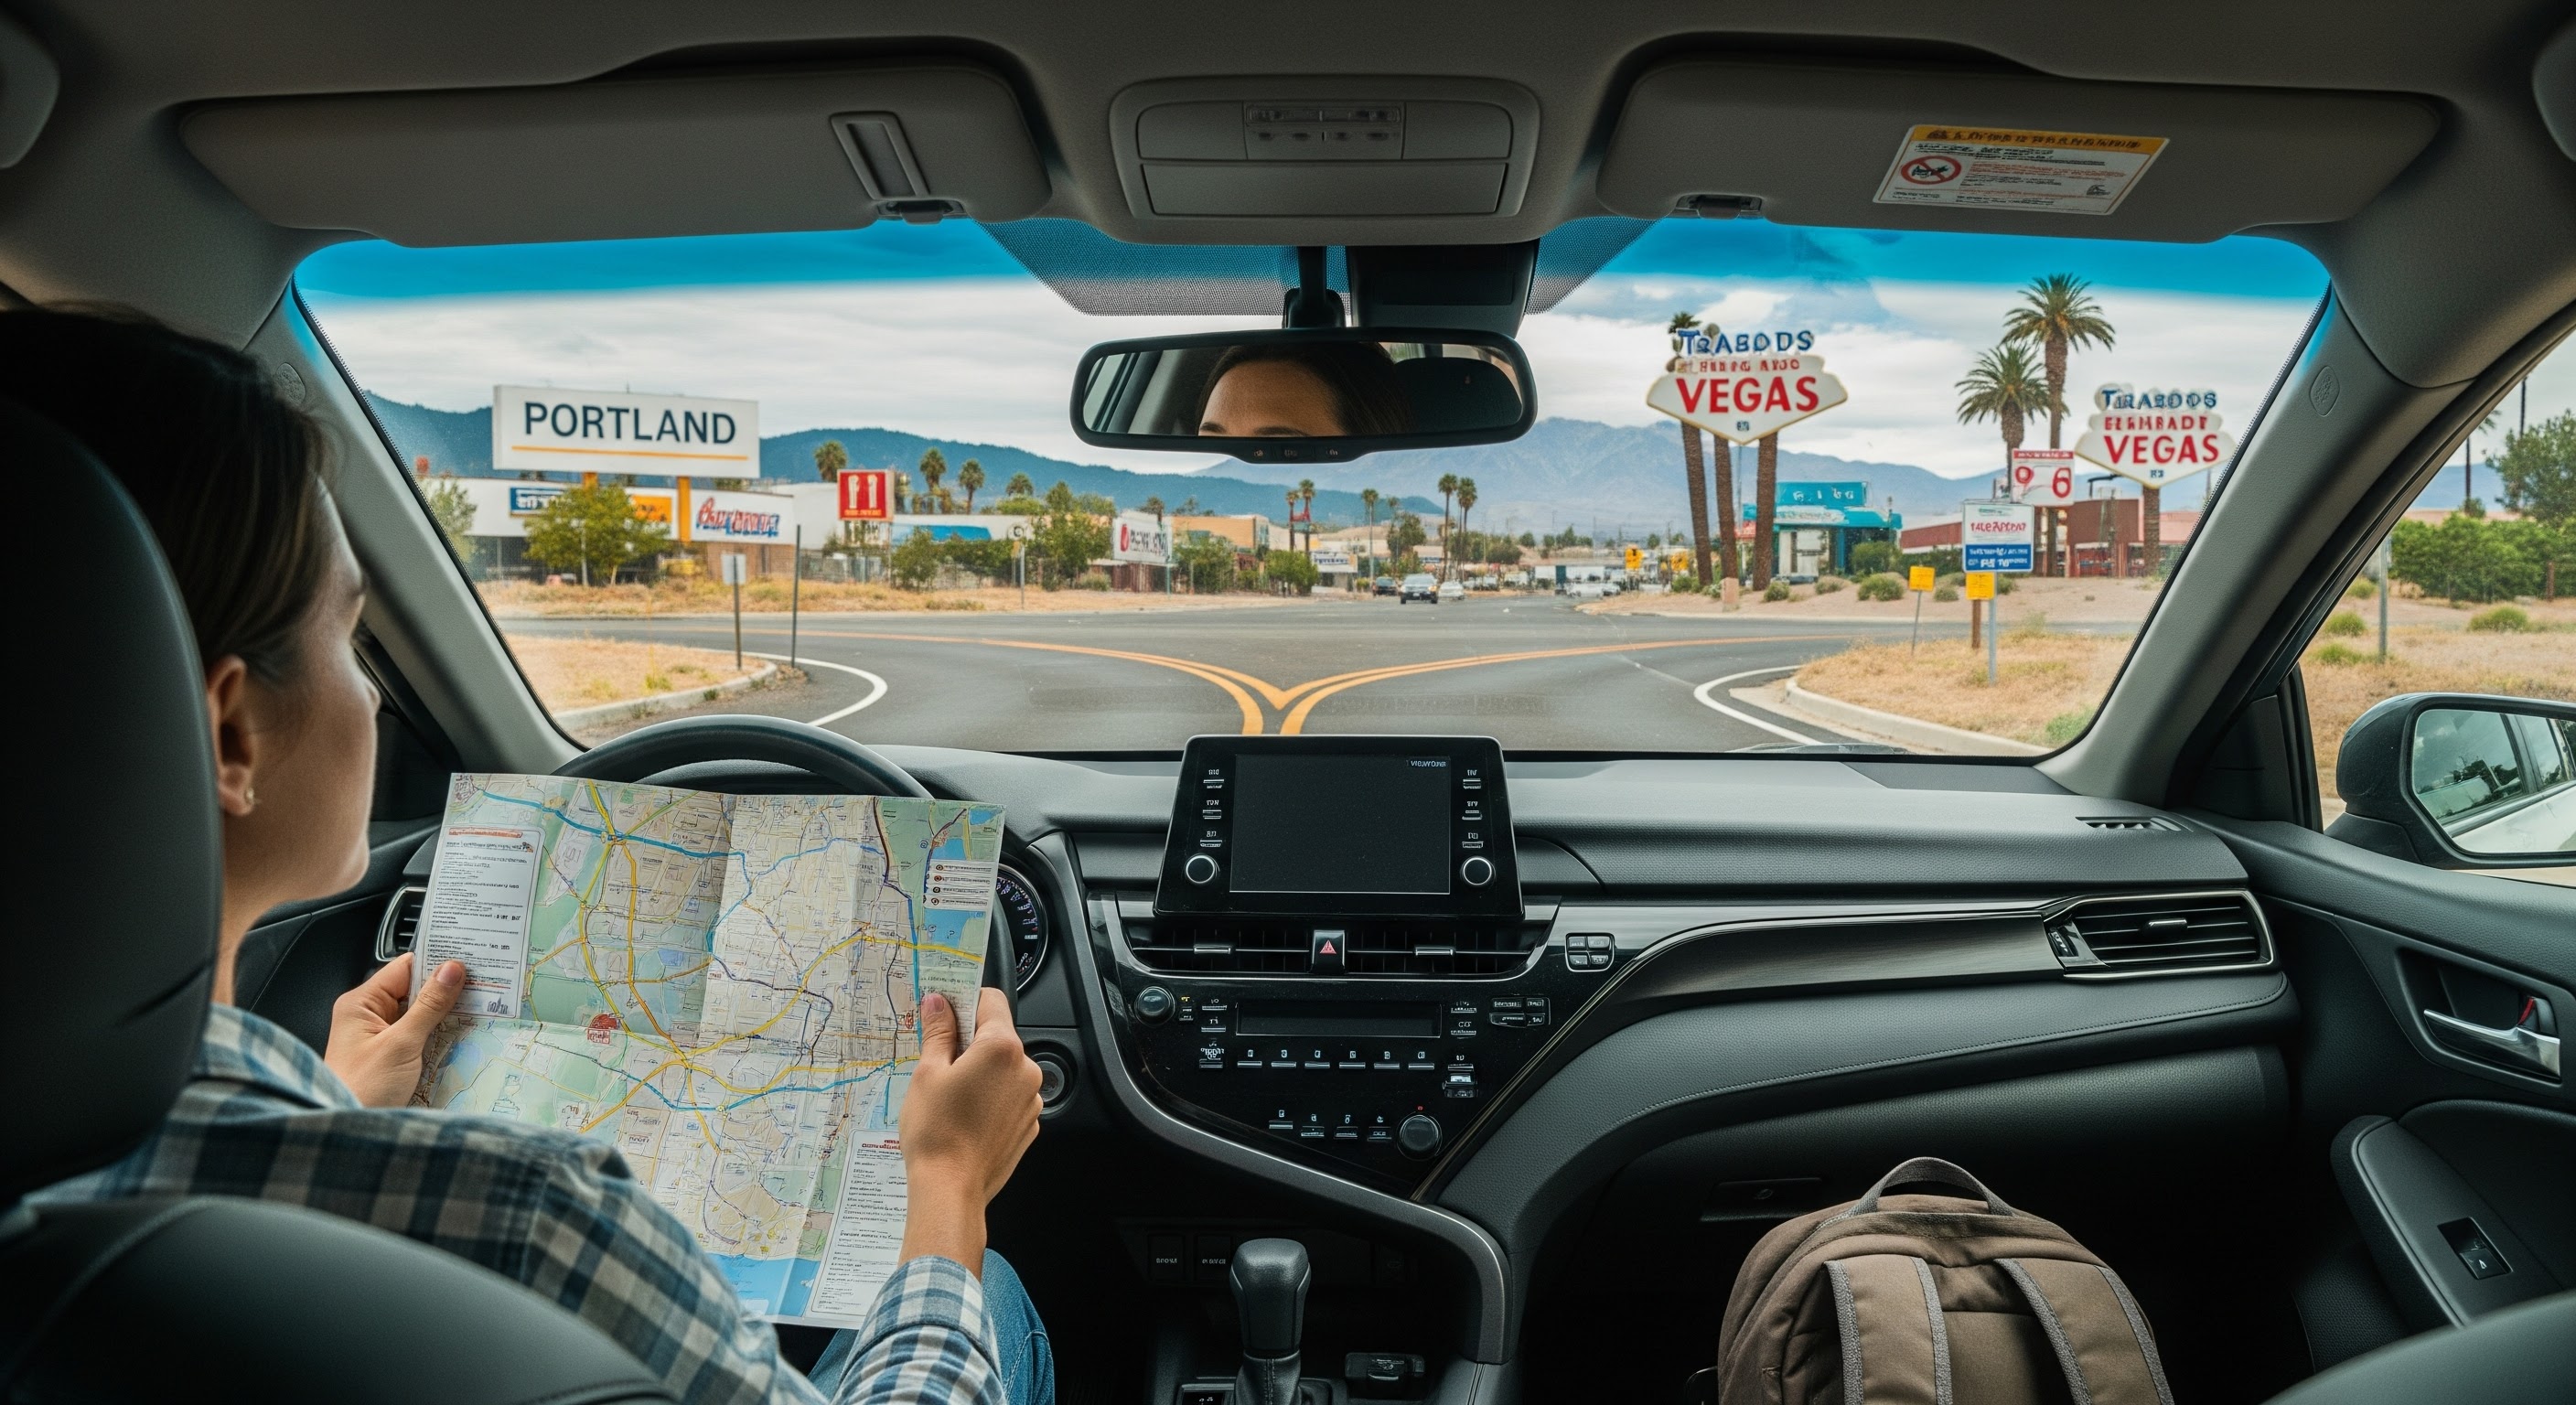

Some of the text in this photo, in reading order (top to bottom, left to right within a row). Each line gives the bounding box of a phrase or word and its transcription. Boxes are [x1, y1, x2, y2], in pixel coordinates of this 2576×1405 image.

[1676, 376, 1819, 414] VEGAS
[524, 402, 736, 445] PORTLAND
[2103, 434, 2219, 464] VEGAS
